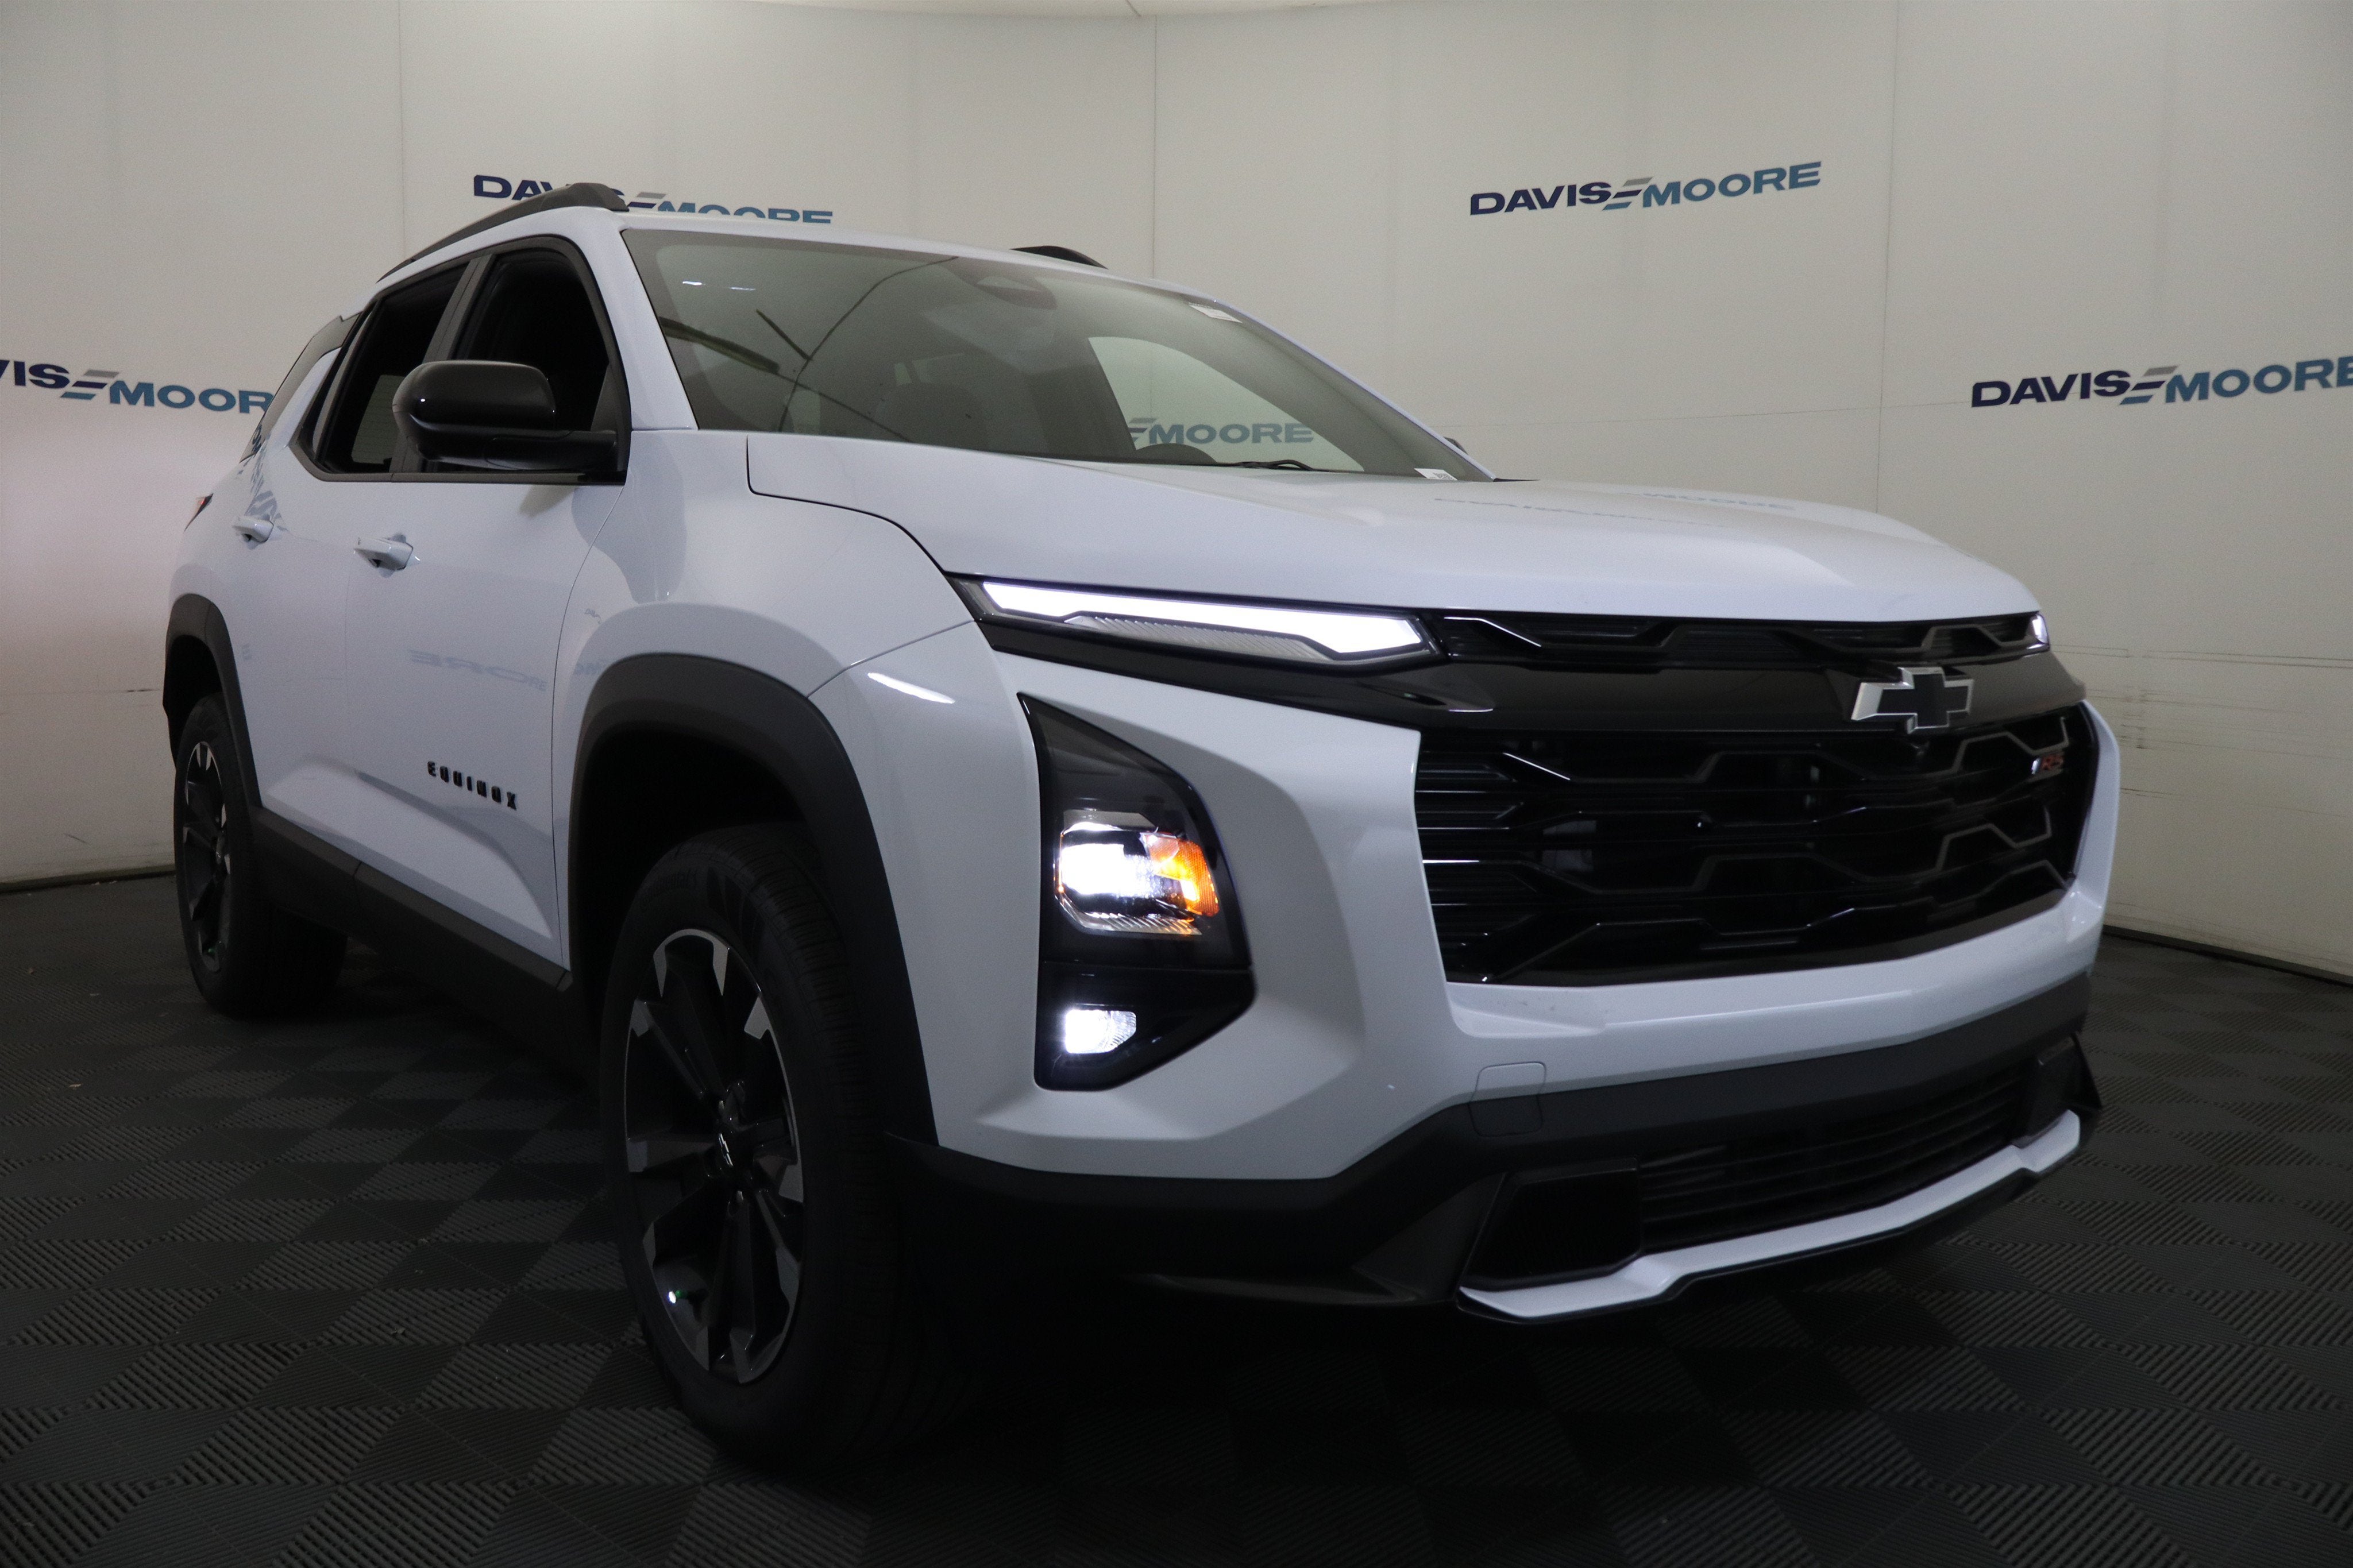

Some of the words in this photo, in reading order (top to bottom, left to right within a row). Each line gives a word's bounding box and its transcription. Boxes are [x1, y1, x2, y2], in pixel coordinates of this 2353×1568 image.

[1470, 181, 1612, 215] DAVIS
[1642, 161, 1822, 208] MOORE
[1971, 370, 2131, 408] DAVIS
[1149, 423, 1314, 444] MOORE
[427, 760, 517, 811] EQUINOX
